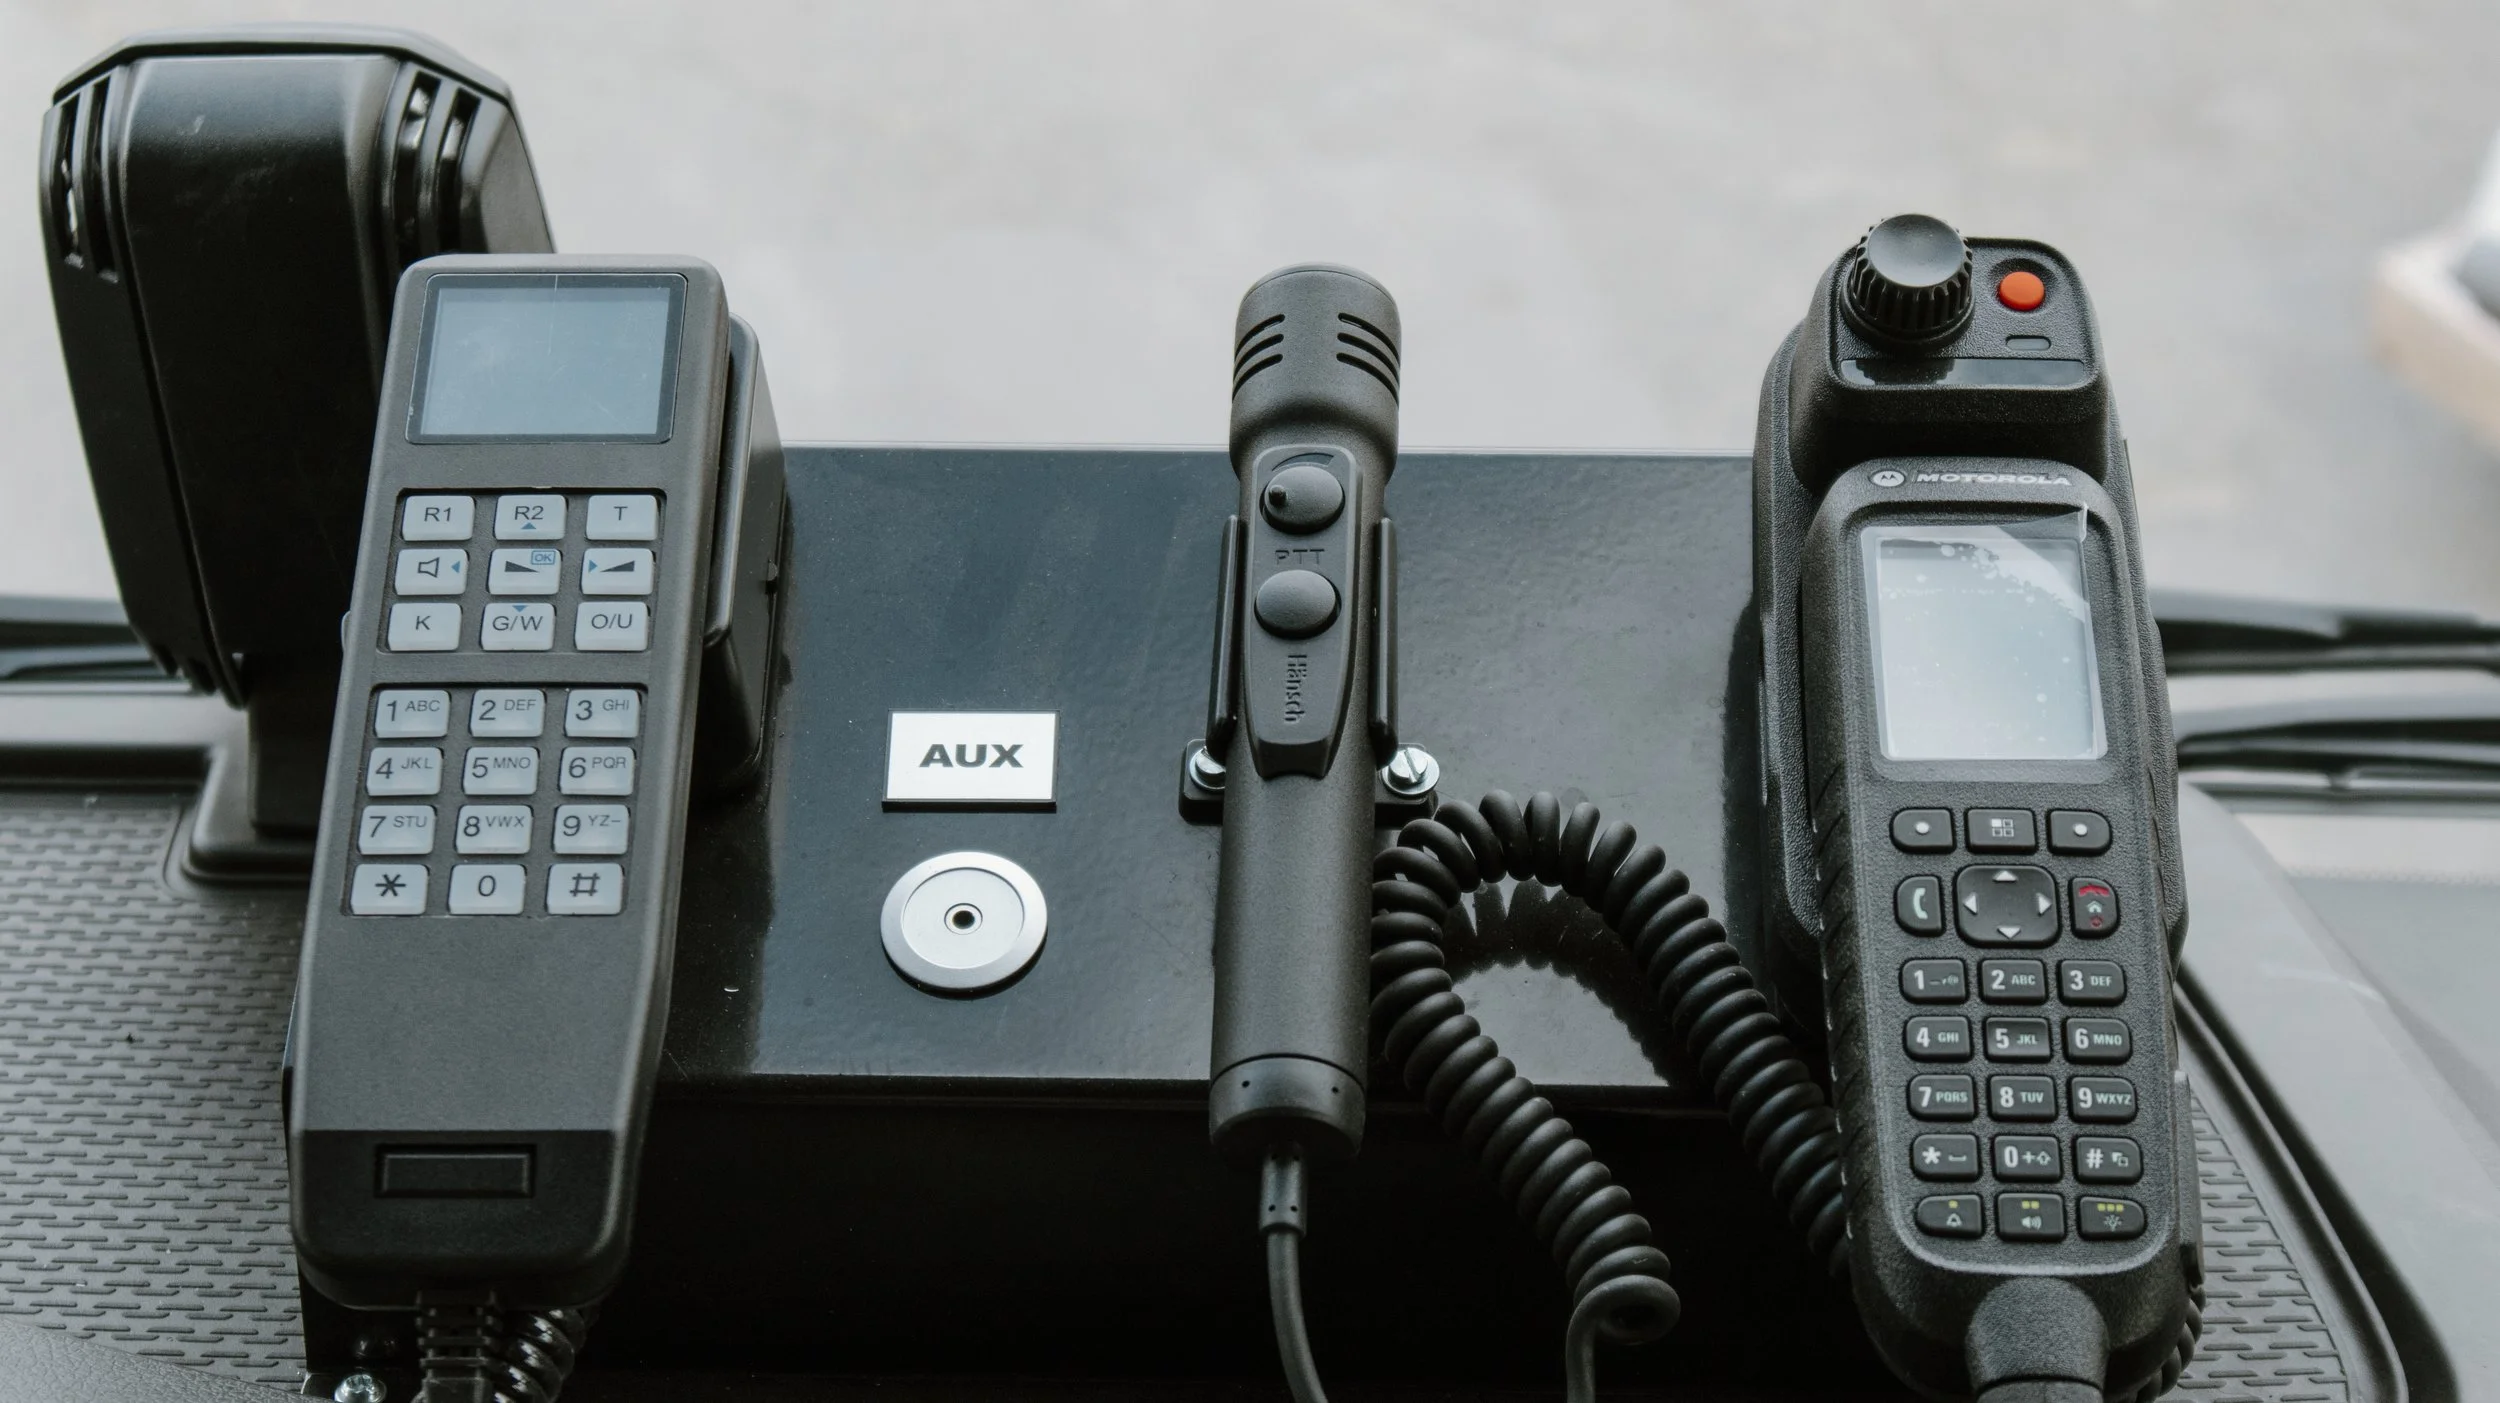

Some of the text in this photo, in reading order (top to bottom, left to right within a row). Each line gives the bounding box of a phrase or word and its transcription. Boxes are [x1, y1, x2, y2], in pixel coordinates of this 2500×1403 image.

[1917, 473, 2072, 486] MOTOROLA
[424, 507, 451, 522] R1
[514, 506, 543, 520] R2
[614, 506, 627, 520] T
[535, 553, 552, 562] OK
[1275, 548, 1325, 565] PTT
[416, 616, 431, 630] K
[492, 616, 543, 631] G/W
[591, 614, 632, 628] O/U
[387, 700, 440, 721] 1 ABC
[479, 700, 536, 721] 2 DEF
[575, 700, 629, 721] 3 GHI
[918, 744, 1024, 768] AUX
[376, 757, 433, 779] 4 JKL
[472, 757, 531, 778] 5 MNO
[569, 757, 626, 778] 6 PQR
[369, 816, 427, 838] 7 STU
[463, 816, 524, 837] 8 VWX
[563, 816, 580, 836] 9
[478, 875, 496, 896] 0
[1914, 970, 1924, 990] 1
[1991, 969, 2036, 990] 2 ABC
[2070, 970, 2112, 990] 3 DEF
[1916, 1027, 1959, 1048] 4 GHI
[1996, 1028, 2037, 1049] 5 JKL
[2075, 1028, 2122, 1049] 6 MNO
[1918, 1086, 1932, 1107] 7
[2000, 1086, 2044, 1108] 8 TUV
[2078, 1087, 2131, 1108] 9 WXYZ
[2004, 1146, 2018, 1168] 0
